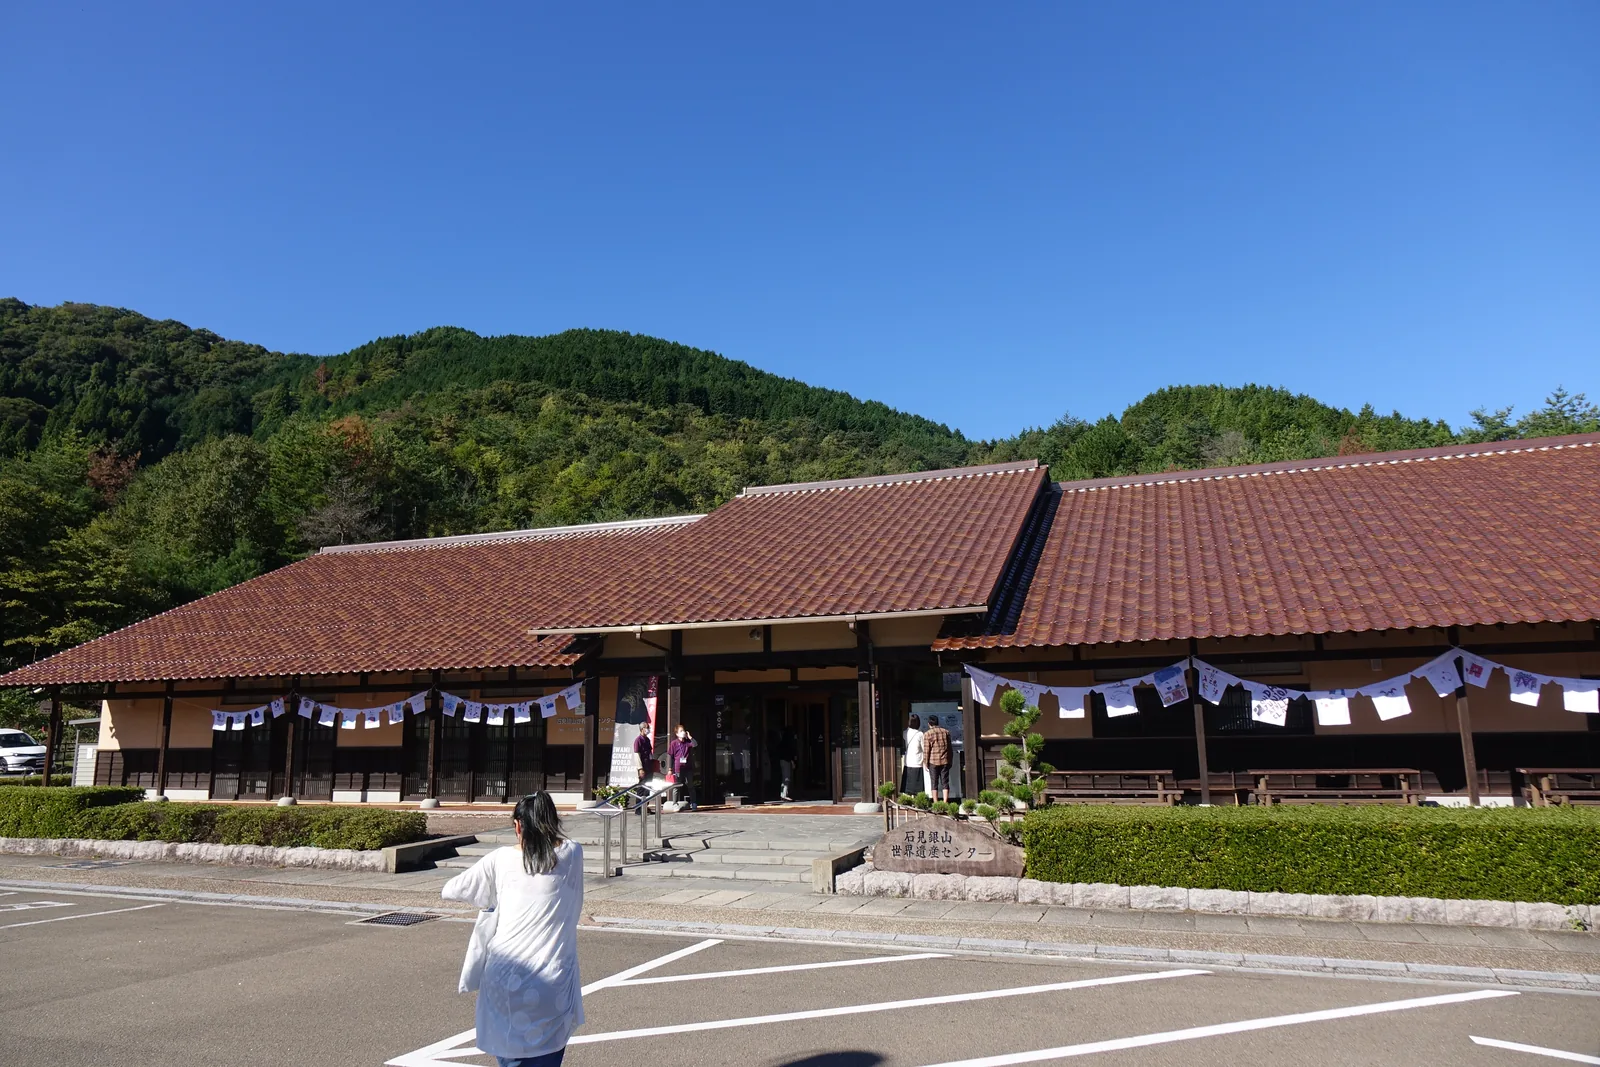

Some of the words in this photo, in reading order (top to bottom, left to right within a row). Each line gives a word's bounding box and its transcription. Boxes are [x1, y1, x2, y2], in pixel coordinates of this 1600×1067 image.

[904, 831, 952, 844] 石見銀山
[892, 844, 992, 859] 世界遺産センター
